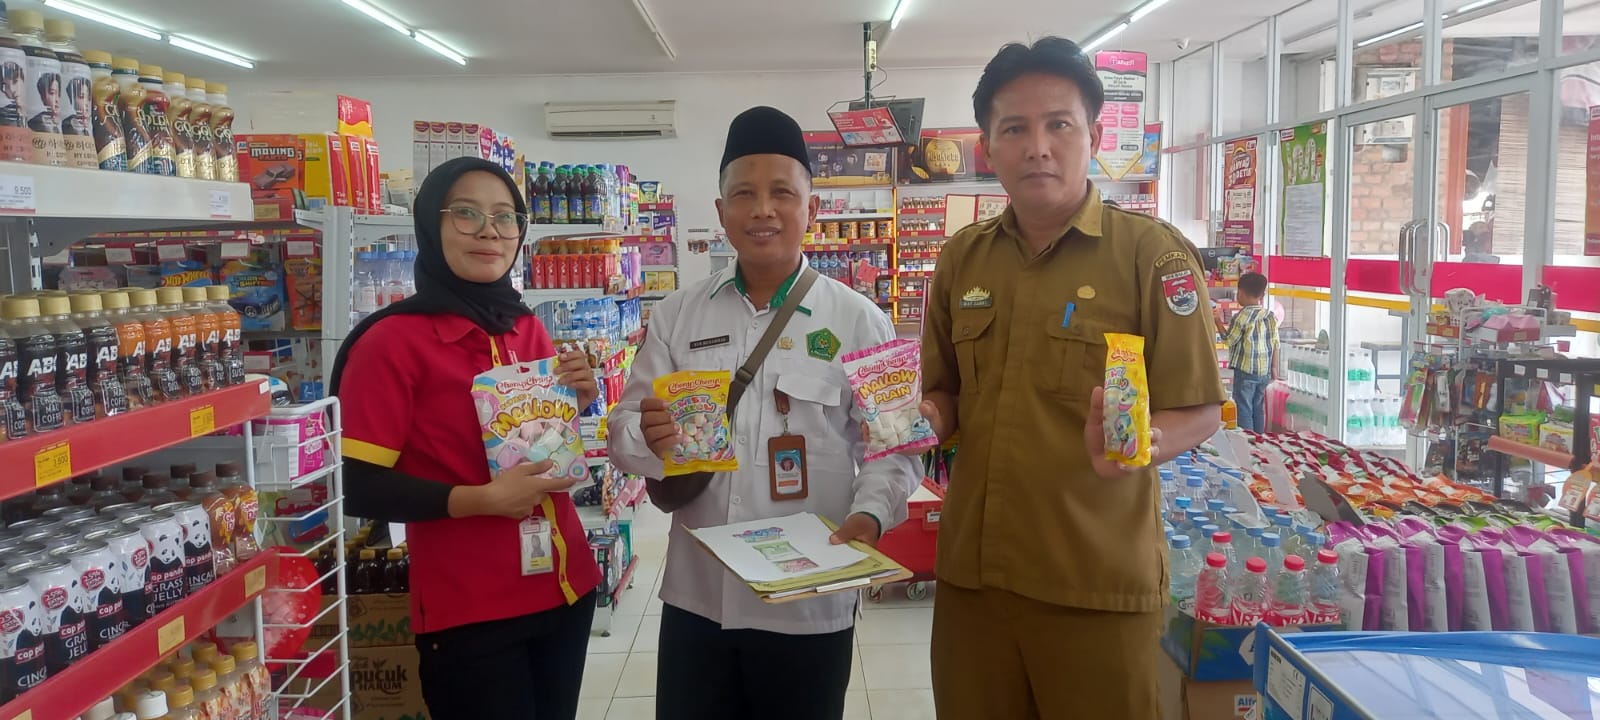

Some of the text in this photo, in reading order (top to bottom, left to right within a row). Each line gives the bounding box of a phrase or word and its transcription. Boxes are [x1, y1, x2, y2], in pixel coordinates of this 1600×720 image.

[859, 369, 917, 399] MALLOW
[874, 385, 911, 405] PLAIN
[153, 587, 183, 602] JELLY
